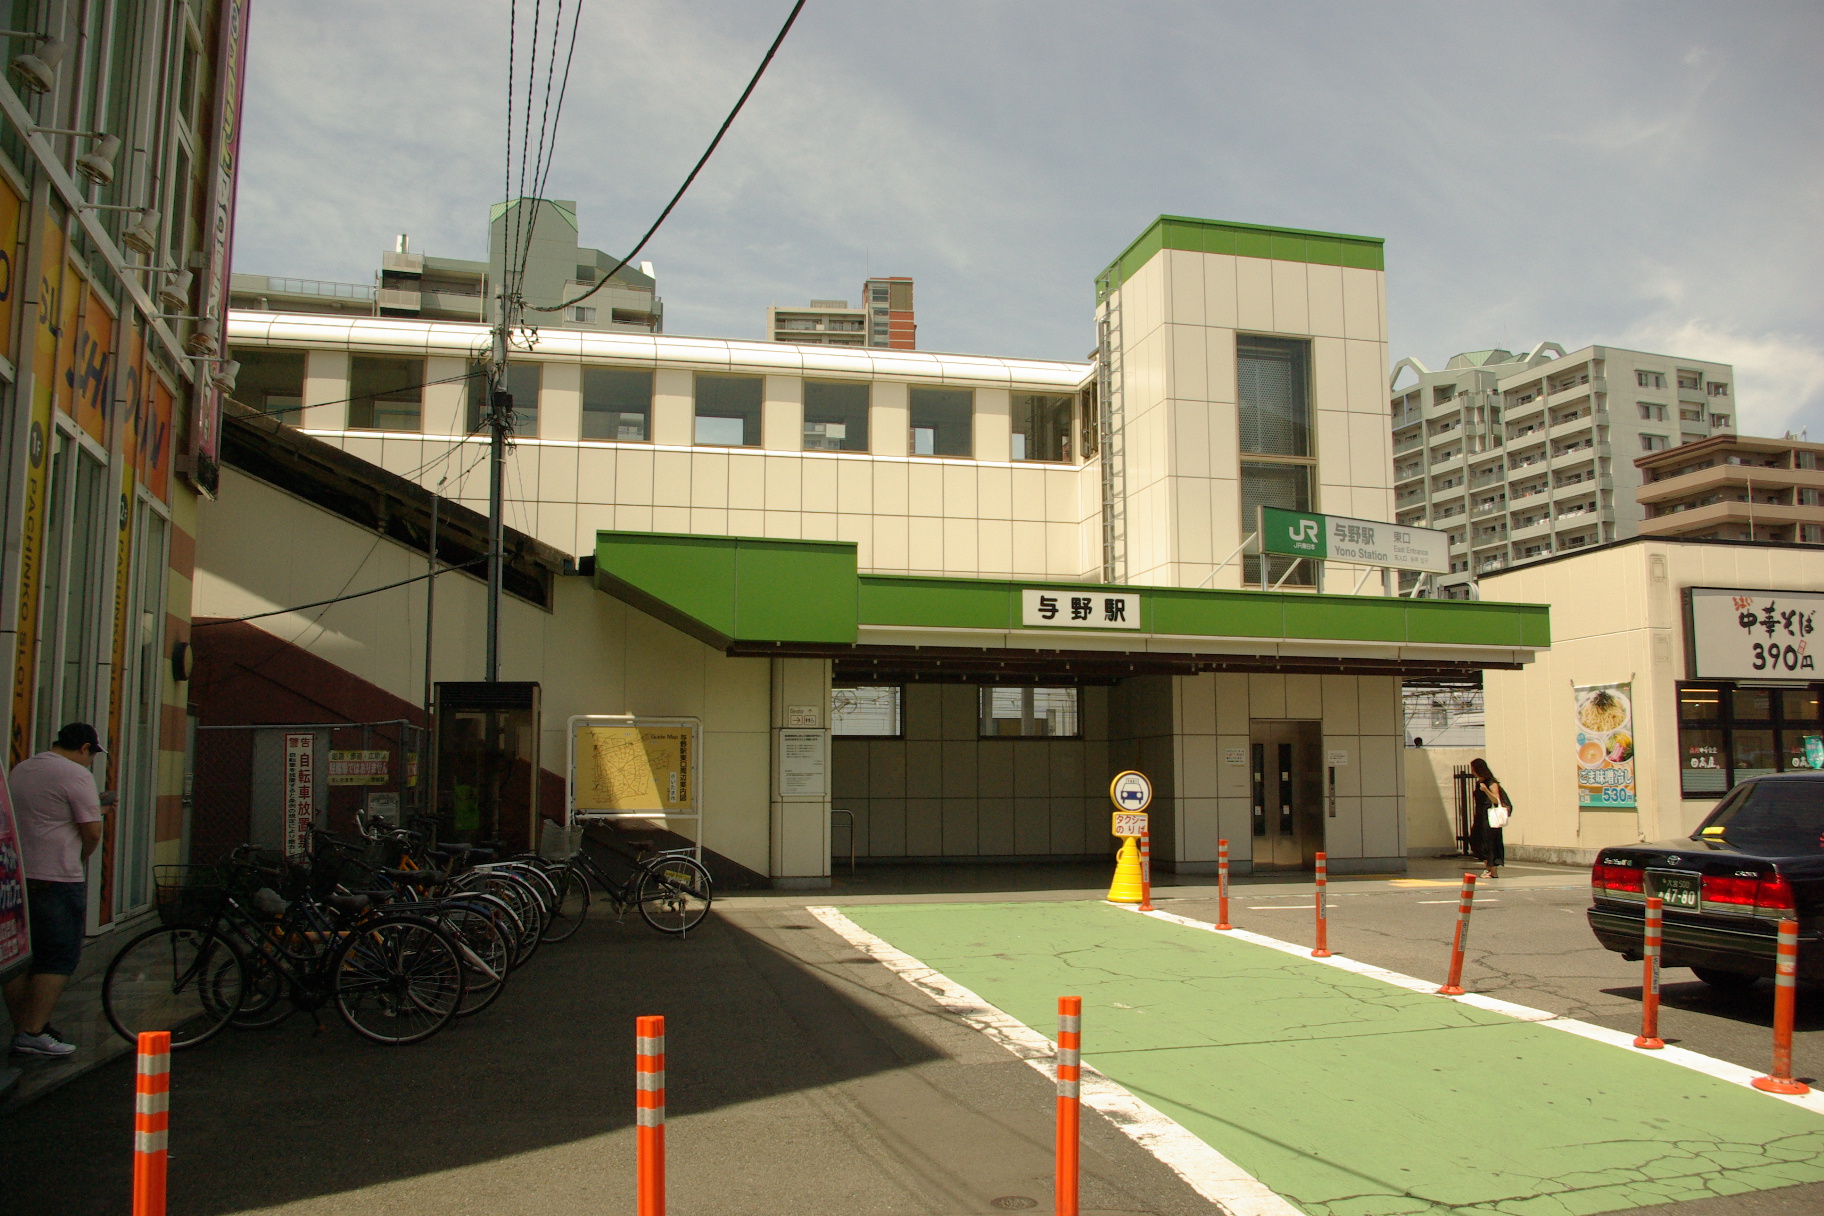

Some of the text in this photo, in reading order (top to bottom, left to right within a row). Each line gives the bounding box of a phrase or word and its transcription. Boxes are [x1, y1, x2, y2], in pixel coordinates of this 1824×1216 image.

[1289, 519, 1318, 543] JR
[1334, 523, 1375, 546] 与野駅
[1393, 531, 1411, 544] 東口
[20, 478, 37, 621] PACHINKO
[1335, 545, 1388, 561] Yono Station
[1038, 595, 1126, 622] 与野駅
[1738, 600, 1817, 639] 中華そば
[1752, 643, 1815, 671] 390円
[1690, 756, 1717, 768] 日高屋
[1580, 769, 1633, 785] ごま味噌冷し
[1116, 815, 1146, 825] タクシー
[1664, 888, 1696, 905] 47-80
